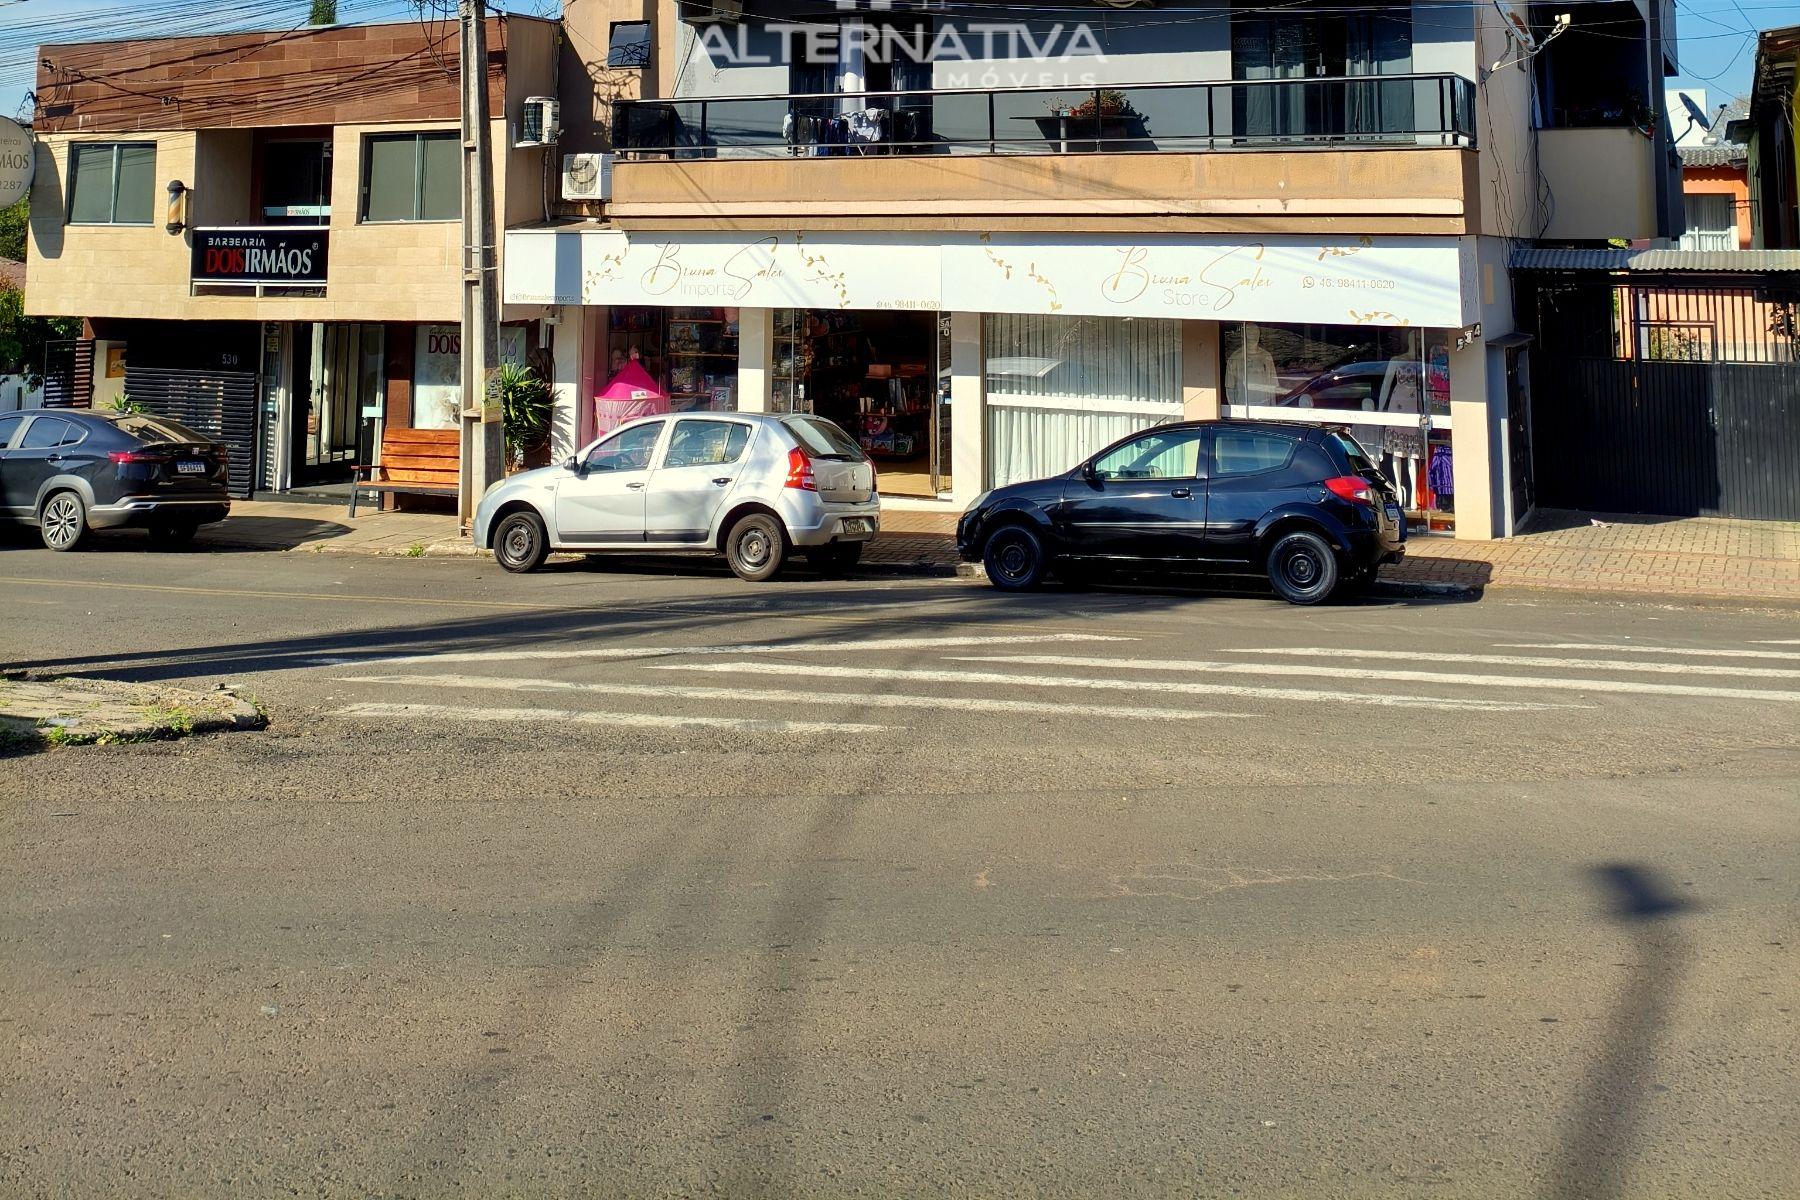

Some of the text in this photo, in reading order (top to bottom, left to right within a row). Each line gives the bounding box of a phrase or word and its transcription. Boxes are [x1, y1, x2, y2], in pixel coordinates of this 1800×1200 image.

[208, 237, 265, 247] BARBEARIA
[680, 279, 735, 298] Imports
[1163, 288, 1209, 306] Store
[222, 353, 238, 365] 530
